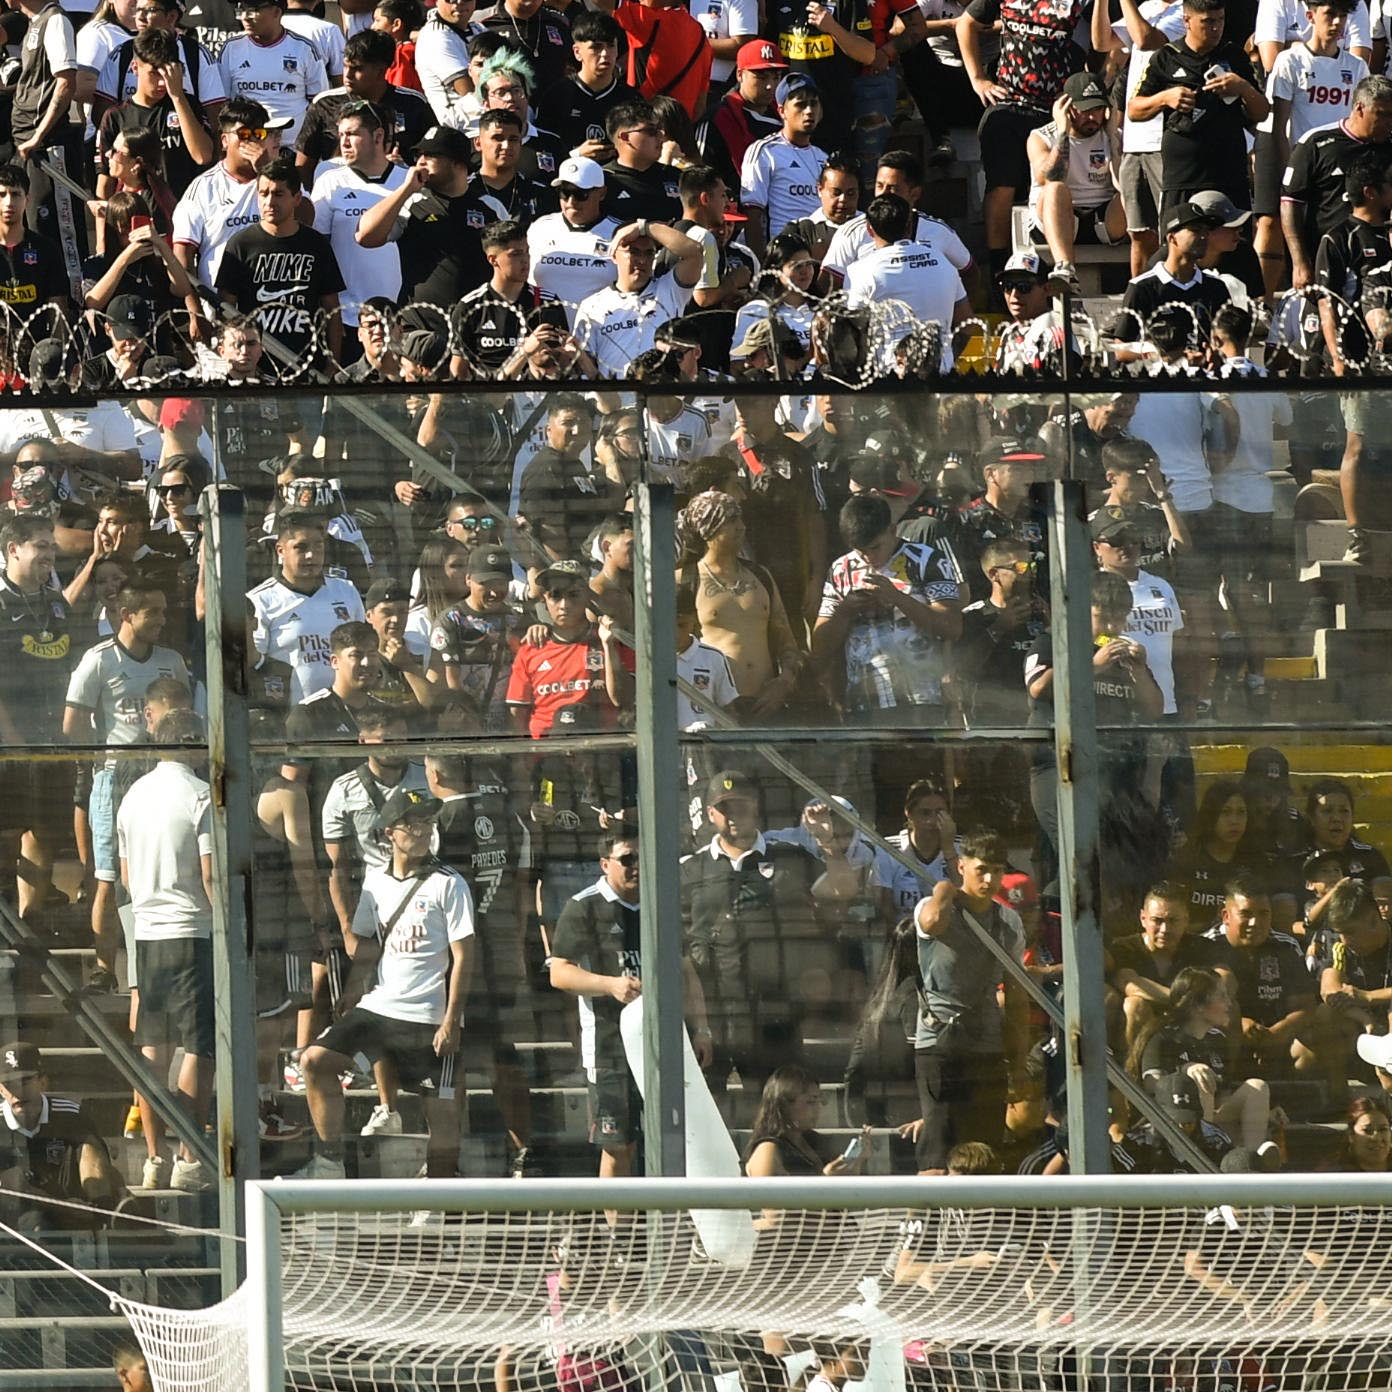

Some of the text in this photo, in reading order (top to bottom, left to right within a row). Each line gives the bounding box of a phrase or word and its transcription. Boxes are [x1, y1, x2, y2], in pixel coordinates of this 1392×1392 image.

[1007, 19, 1051, 38] COOLBET
[778, 38, 830, 56] CRISTAL
[236, 81, 283, 93] COOLBET
[1306, 85, 1351, 107] 1991
[253, 253, 315, 284] NIKE
[540, 255, 593, 267] COOLBET
[890, 253, 931, 267] ASSIST
[909, 260, 938, 270] CARD
[279, 293, 306, 306] AIR
[256, 308, 311, 334] NIKE
[536, 681, 591, 697] COOLBET
[471, 849, 508, 869] PAREDES
[474, 868, 504, 914] 7
